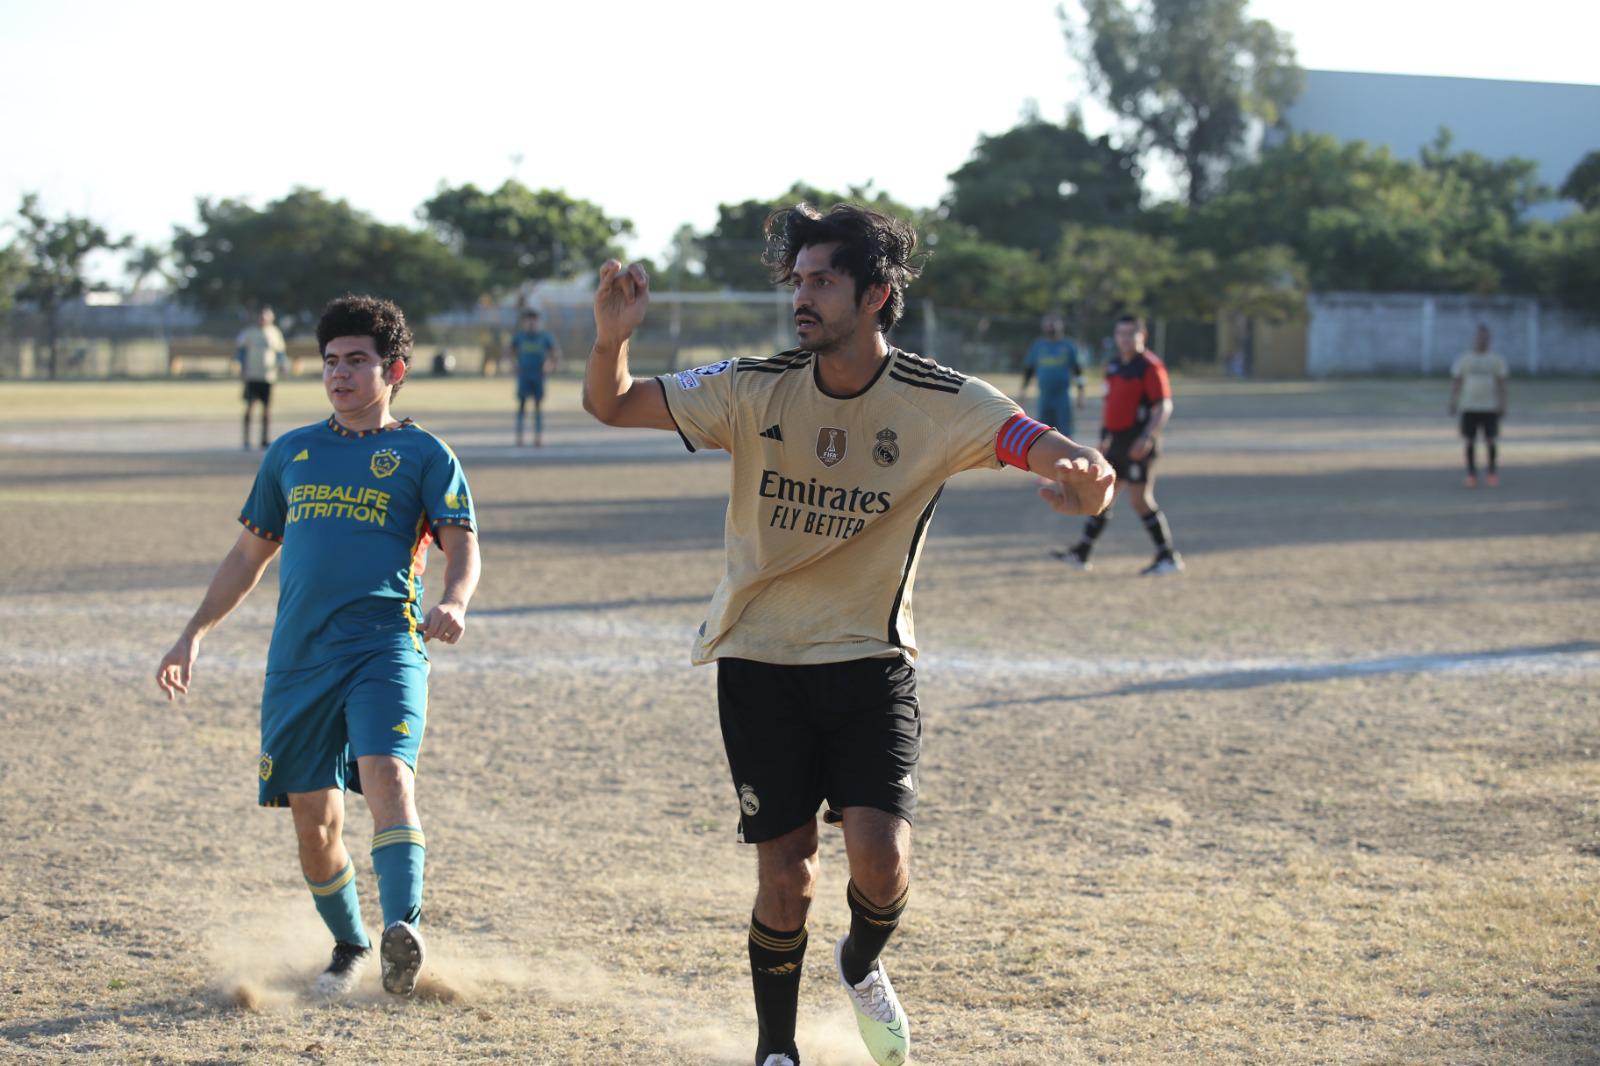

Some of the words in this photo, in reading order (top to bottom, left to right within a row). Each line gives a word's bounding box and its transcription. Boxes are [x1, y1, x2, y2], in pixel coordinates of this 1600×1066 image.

[759, 469, 891, 514] Emirates
[286, 502, 386, 527] NUTRITION
[770, 505, 801, 531] FLY
[803, 511, 865, 540] BETTER
